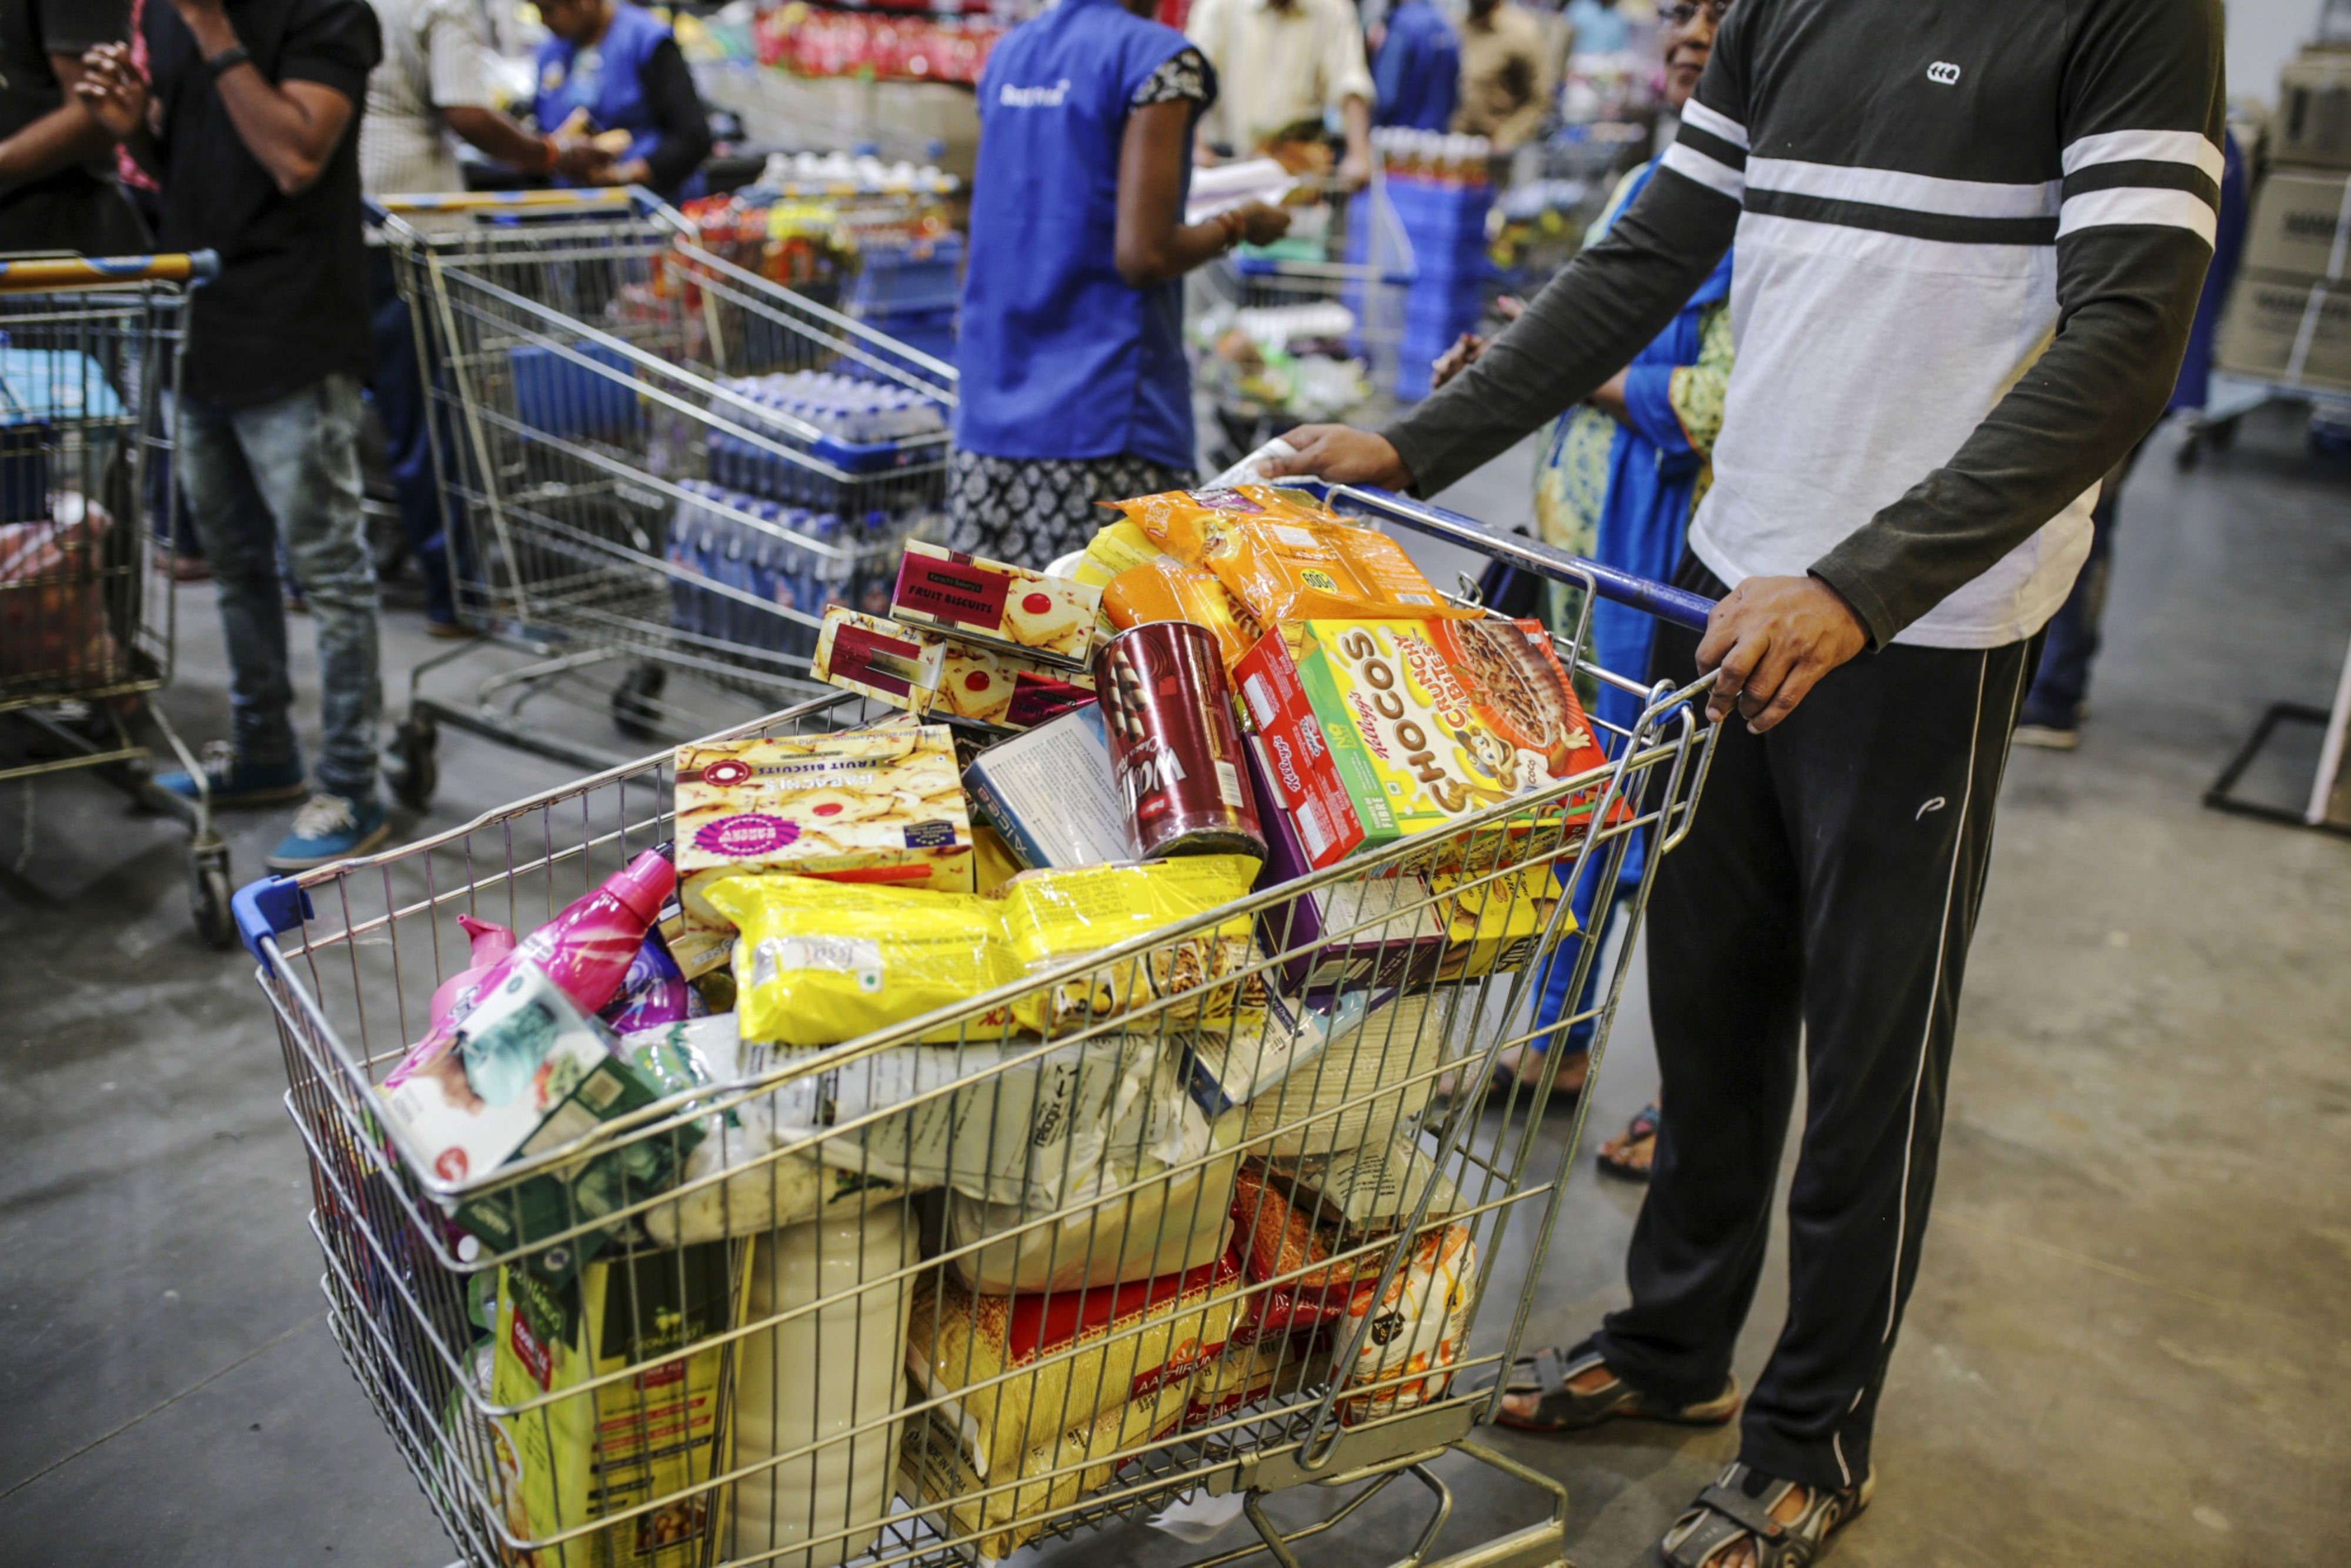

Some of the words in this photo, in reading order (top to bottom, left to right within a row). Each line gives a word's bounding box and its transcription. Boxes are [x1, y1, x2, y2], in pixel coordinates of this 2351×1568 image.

[908, 585, 943, 601] FRUIT
[944, 594, 993, 613] BISCUITS
[1392, 634, 1467, 728] CRUNCHY
[1423, 646, 1466, 702] BITES
[1343, 632, 1466, 813] CHOCOS
[1349, 690, 1390, 760] Kellogg's
[758, 764, 824, 775] BISCUITS
[830, 760, 876, 770] FRUIT
[1275, 735, 1300, 791] Kellogg's
[1528, 759, 1537, 784] COCO
[977, 785, 1031, 855] Alcea
[1373, 797, 1394, 828] FIBRE
